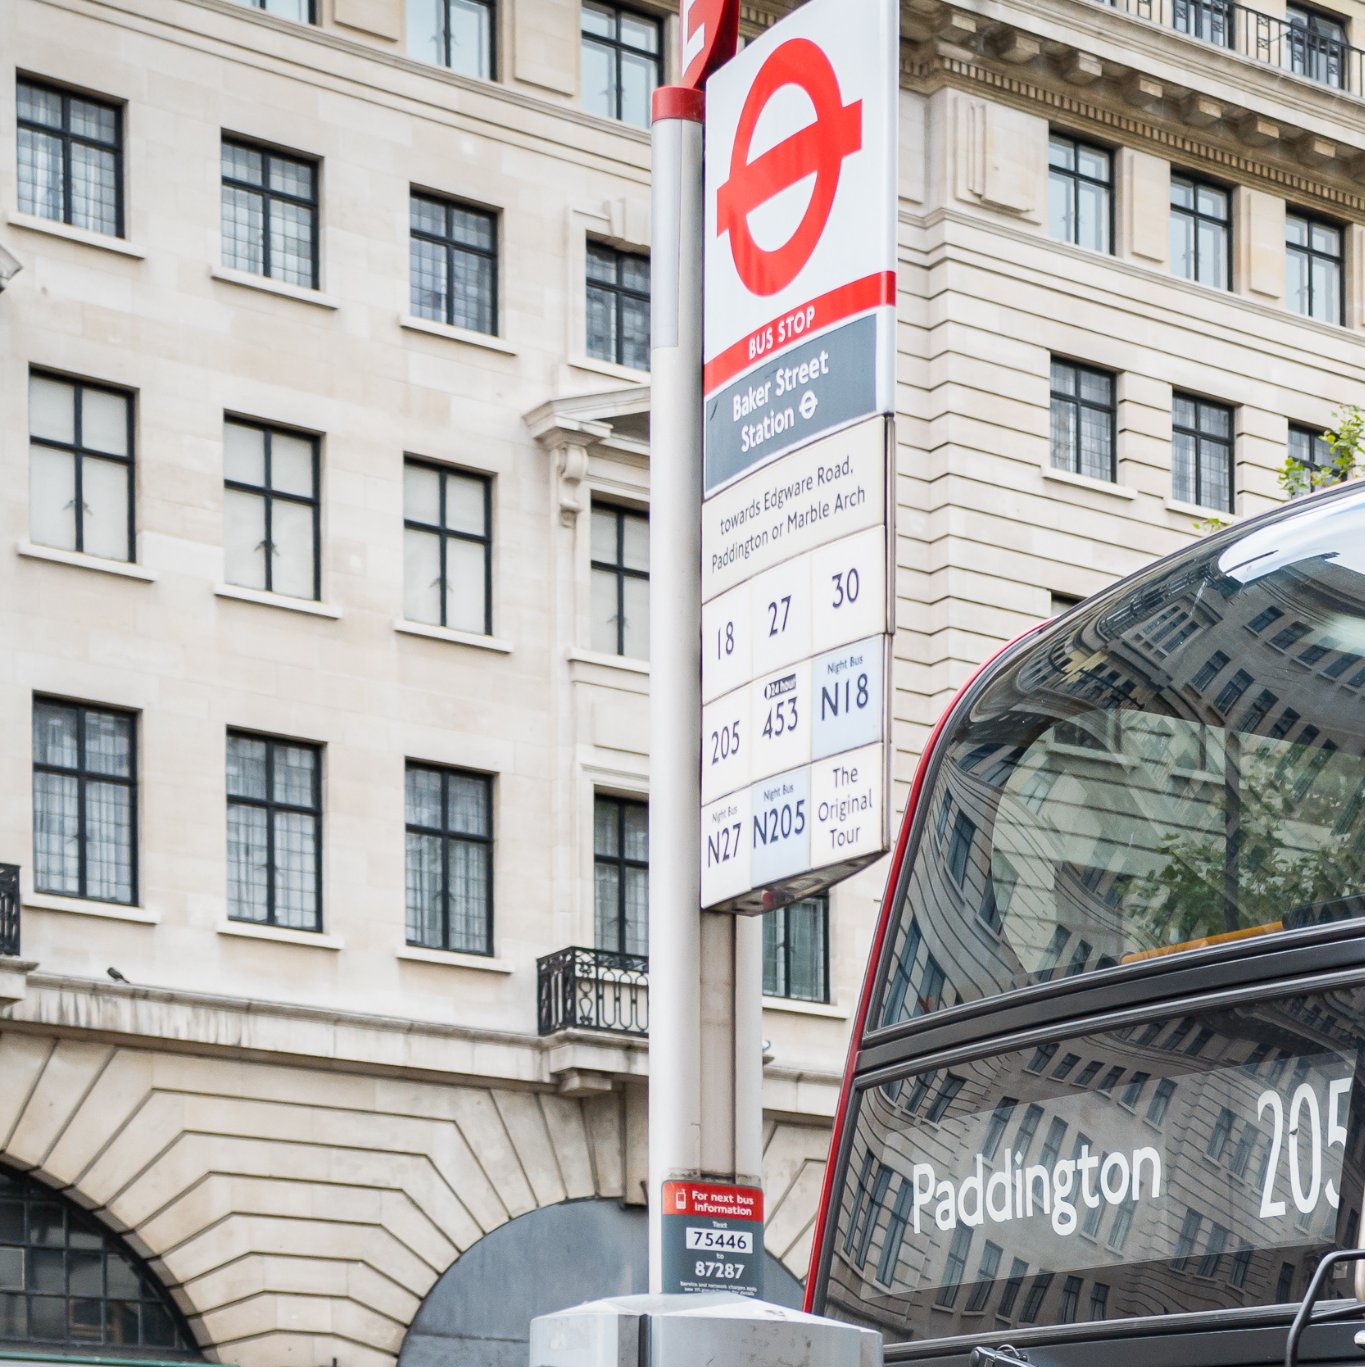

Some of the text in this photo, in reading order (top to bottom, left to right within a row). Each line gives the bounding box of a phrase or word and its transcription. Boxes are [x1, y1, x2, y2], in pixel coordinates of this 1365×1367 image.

[748, 305, 816, 361] BUS STOP
[733, 349, 830, 423] Baker Street
[741, 409, 796, 454] Station
[720, 455, 855, 537] towards Edgware Road,
[711, 486, 866, 575] Paddington or Marble Arch
[717, 567, 860, 661] 18 27 30
[827, 659, 849, 677] Night
[851, 653, 864, 670] Bus
[711, 673, 869, 766] 205 453 N18
[763, 785, 780, 802] Night
[782, 781, 794, 796] Bus
[832, 766, 859, 790] The
[818, 789, 874, 824] Original
[707, 799, 807, 869] N27 N205
[829, 824, 862, 850] Tour
[912, 1076, 1354, 1237] Paddington 205
[692, 1190, 754, 1206] For next bus
[695, 1202, 752, 1216] information
[694, 1231, 747, 1250] 75446
[712, 1221, 728, 1229] Text
[695, 1260, 745, 1280] 87287
